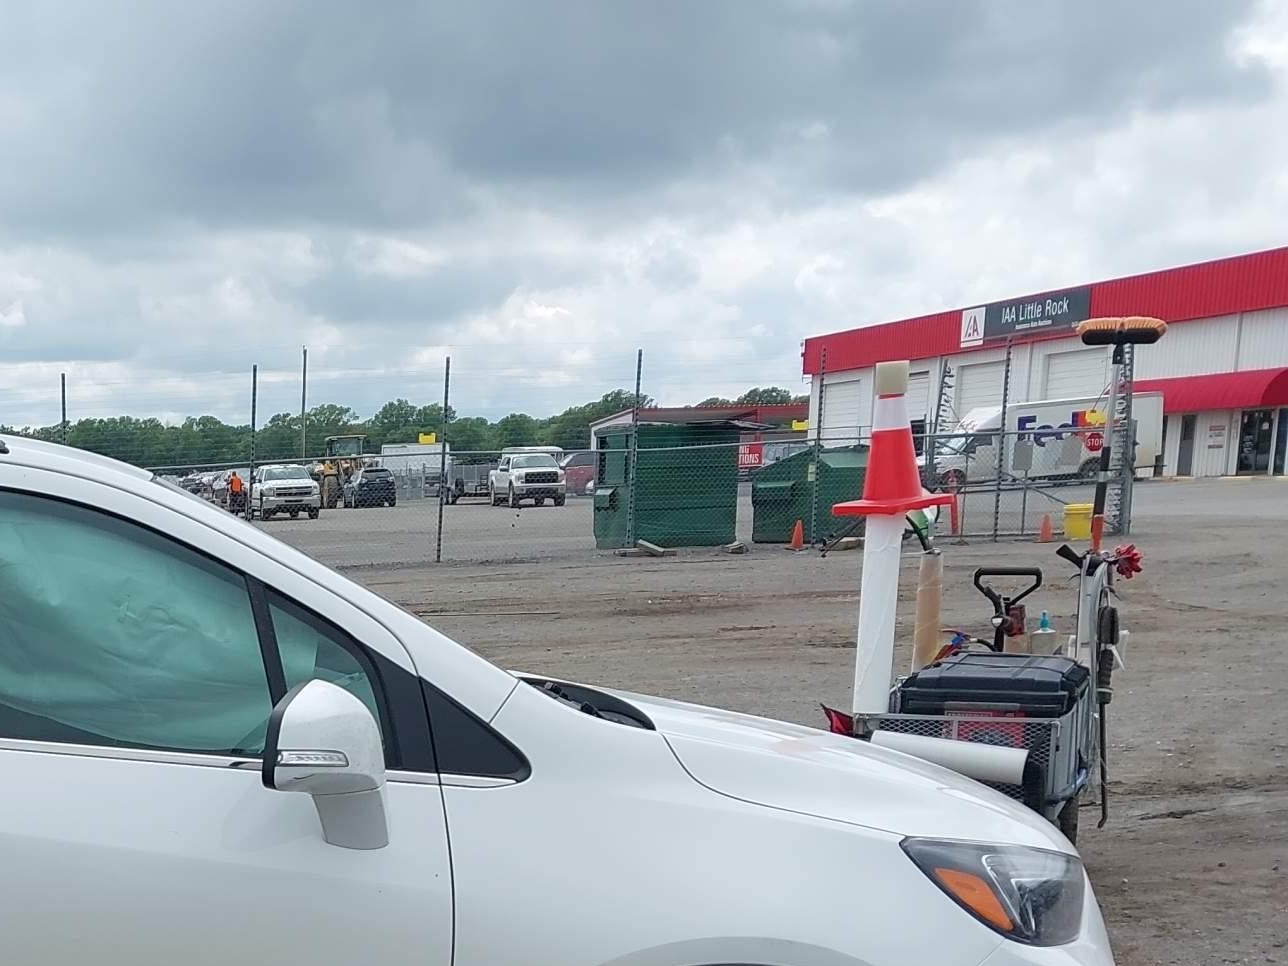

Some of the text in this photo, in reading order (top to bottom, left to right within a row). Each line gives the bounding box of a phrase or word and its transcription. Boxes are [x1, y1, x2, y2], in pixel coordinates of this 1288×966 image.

[1001, 296, 1069, 324] IAA Little Rock
[1017, 411, 1102, 447] Fed
[1087, 438, 1104, 447] STOP
